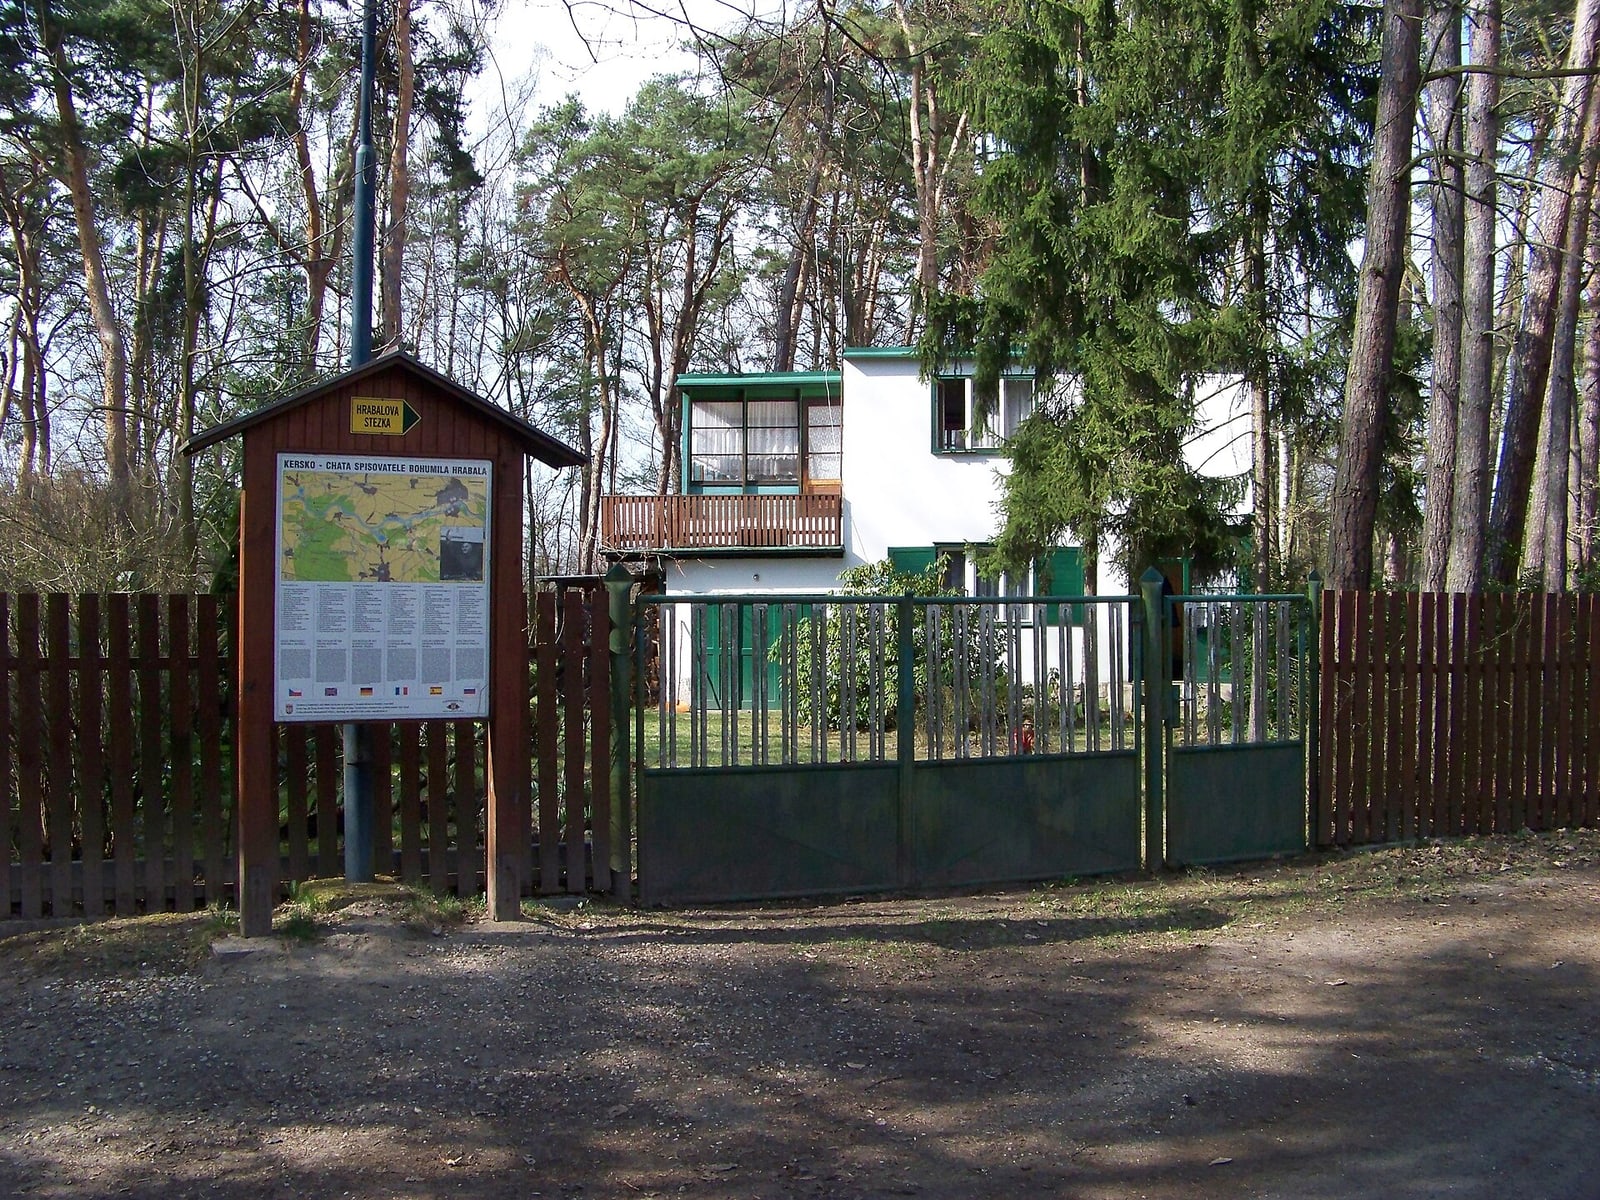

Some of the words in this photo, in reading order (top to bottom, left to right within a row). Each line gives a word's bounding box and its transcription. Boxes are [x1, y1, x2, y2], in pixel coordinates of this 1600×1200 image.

[356, 404, 399, 416] HRABALOVA
[364, 417, 391, 428] STEZKA
[283, 460, 316, 469] KERSKO
[326, 461, 352, 470] CHATA
[354, 462, 406, 472] SPISOVATELE
[409, 464, 450, 474] BOHUMILA
[452, 465, 487, 475] HRABALA
